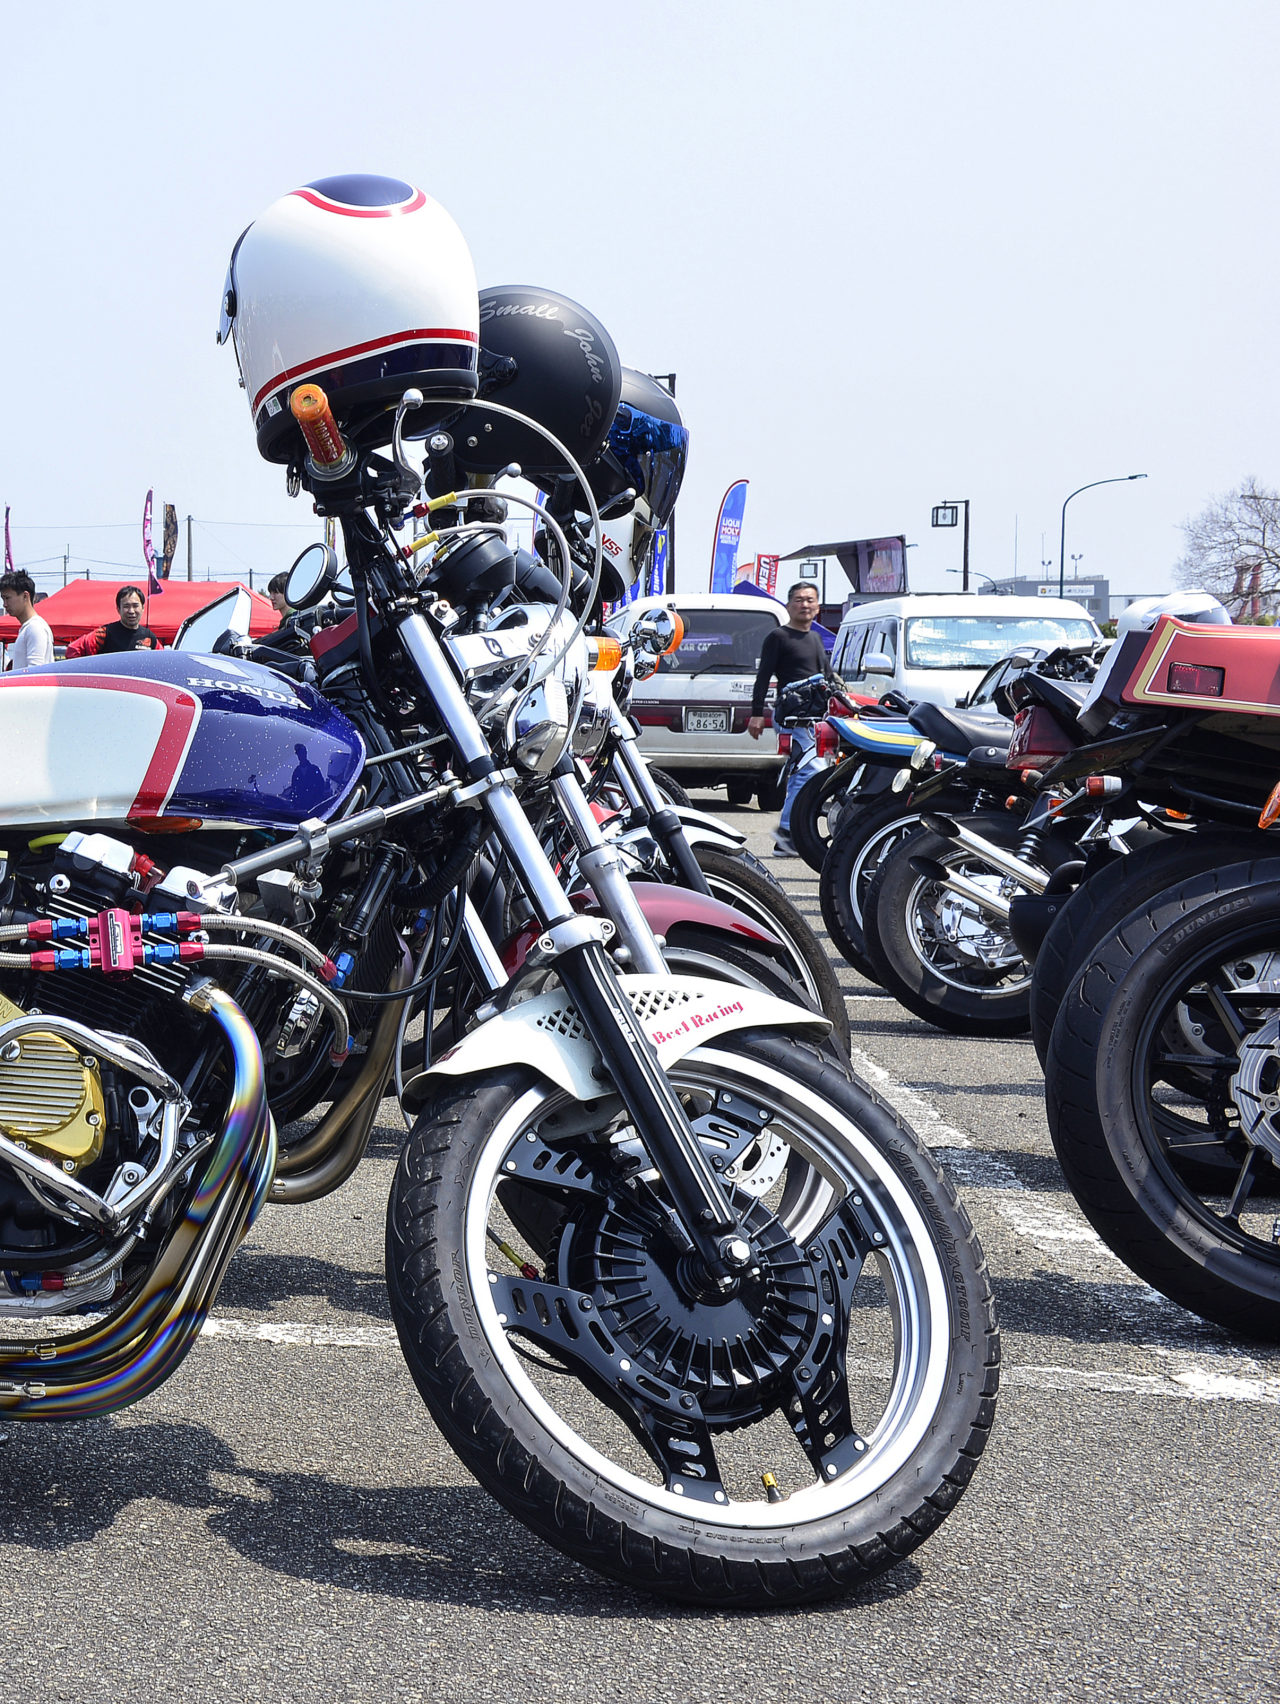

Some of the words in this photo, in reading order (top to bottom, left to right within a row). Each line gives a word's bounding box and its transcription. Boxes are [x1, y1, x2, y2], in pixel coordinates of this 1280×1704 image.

[480, 300, 559, 324] Small
[563, 328, 604, 384] John
[721, 526, 740, 536] MOLY
[722, 517, 740, 527] LIQUI
[186, 677, 312, 710] HONDA
[696, 719, 724, 729] 86-54
[1172, 898, 1246, 942] DUNLOP
[690, 1001, 744, 1028] Racing
[888, 1147, 961, 1272] ARROWMAX
[952, 1269, 970, 1343] GT601F
[451, 1250, 481, 1341] DUNLOP
